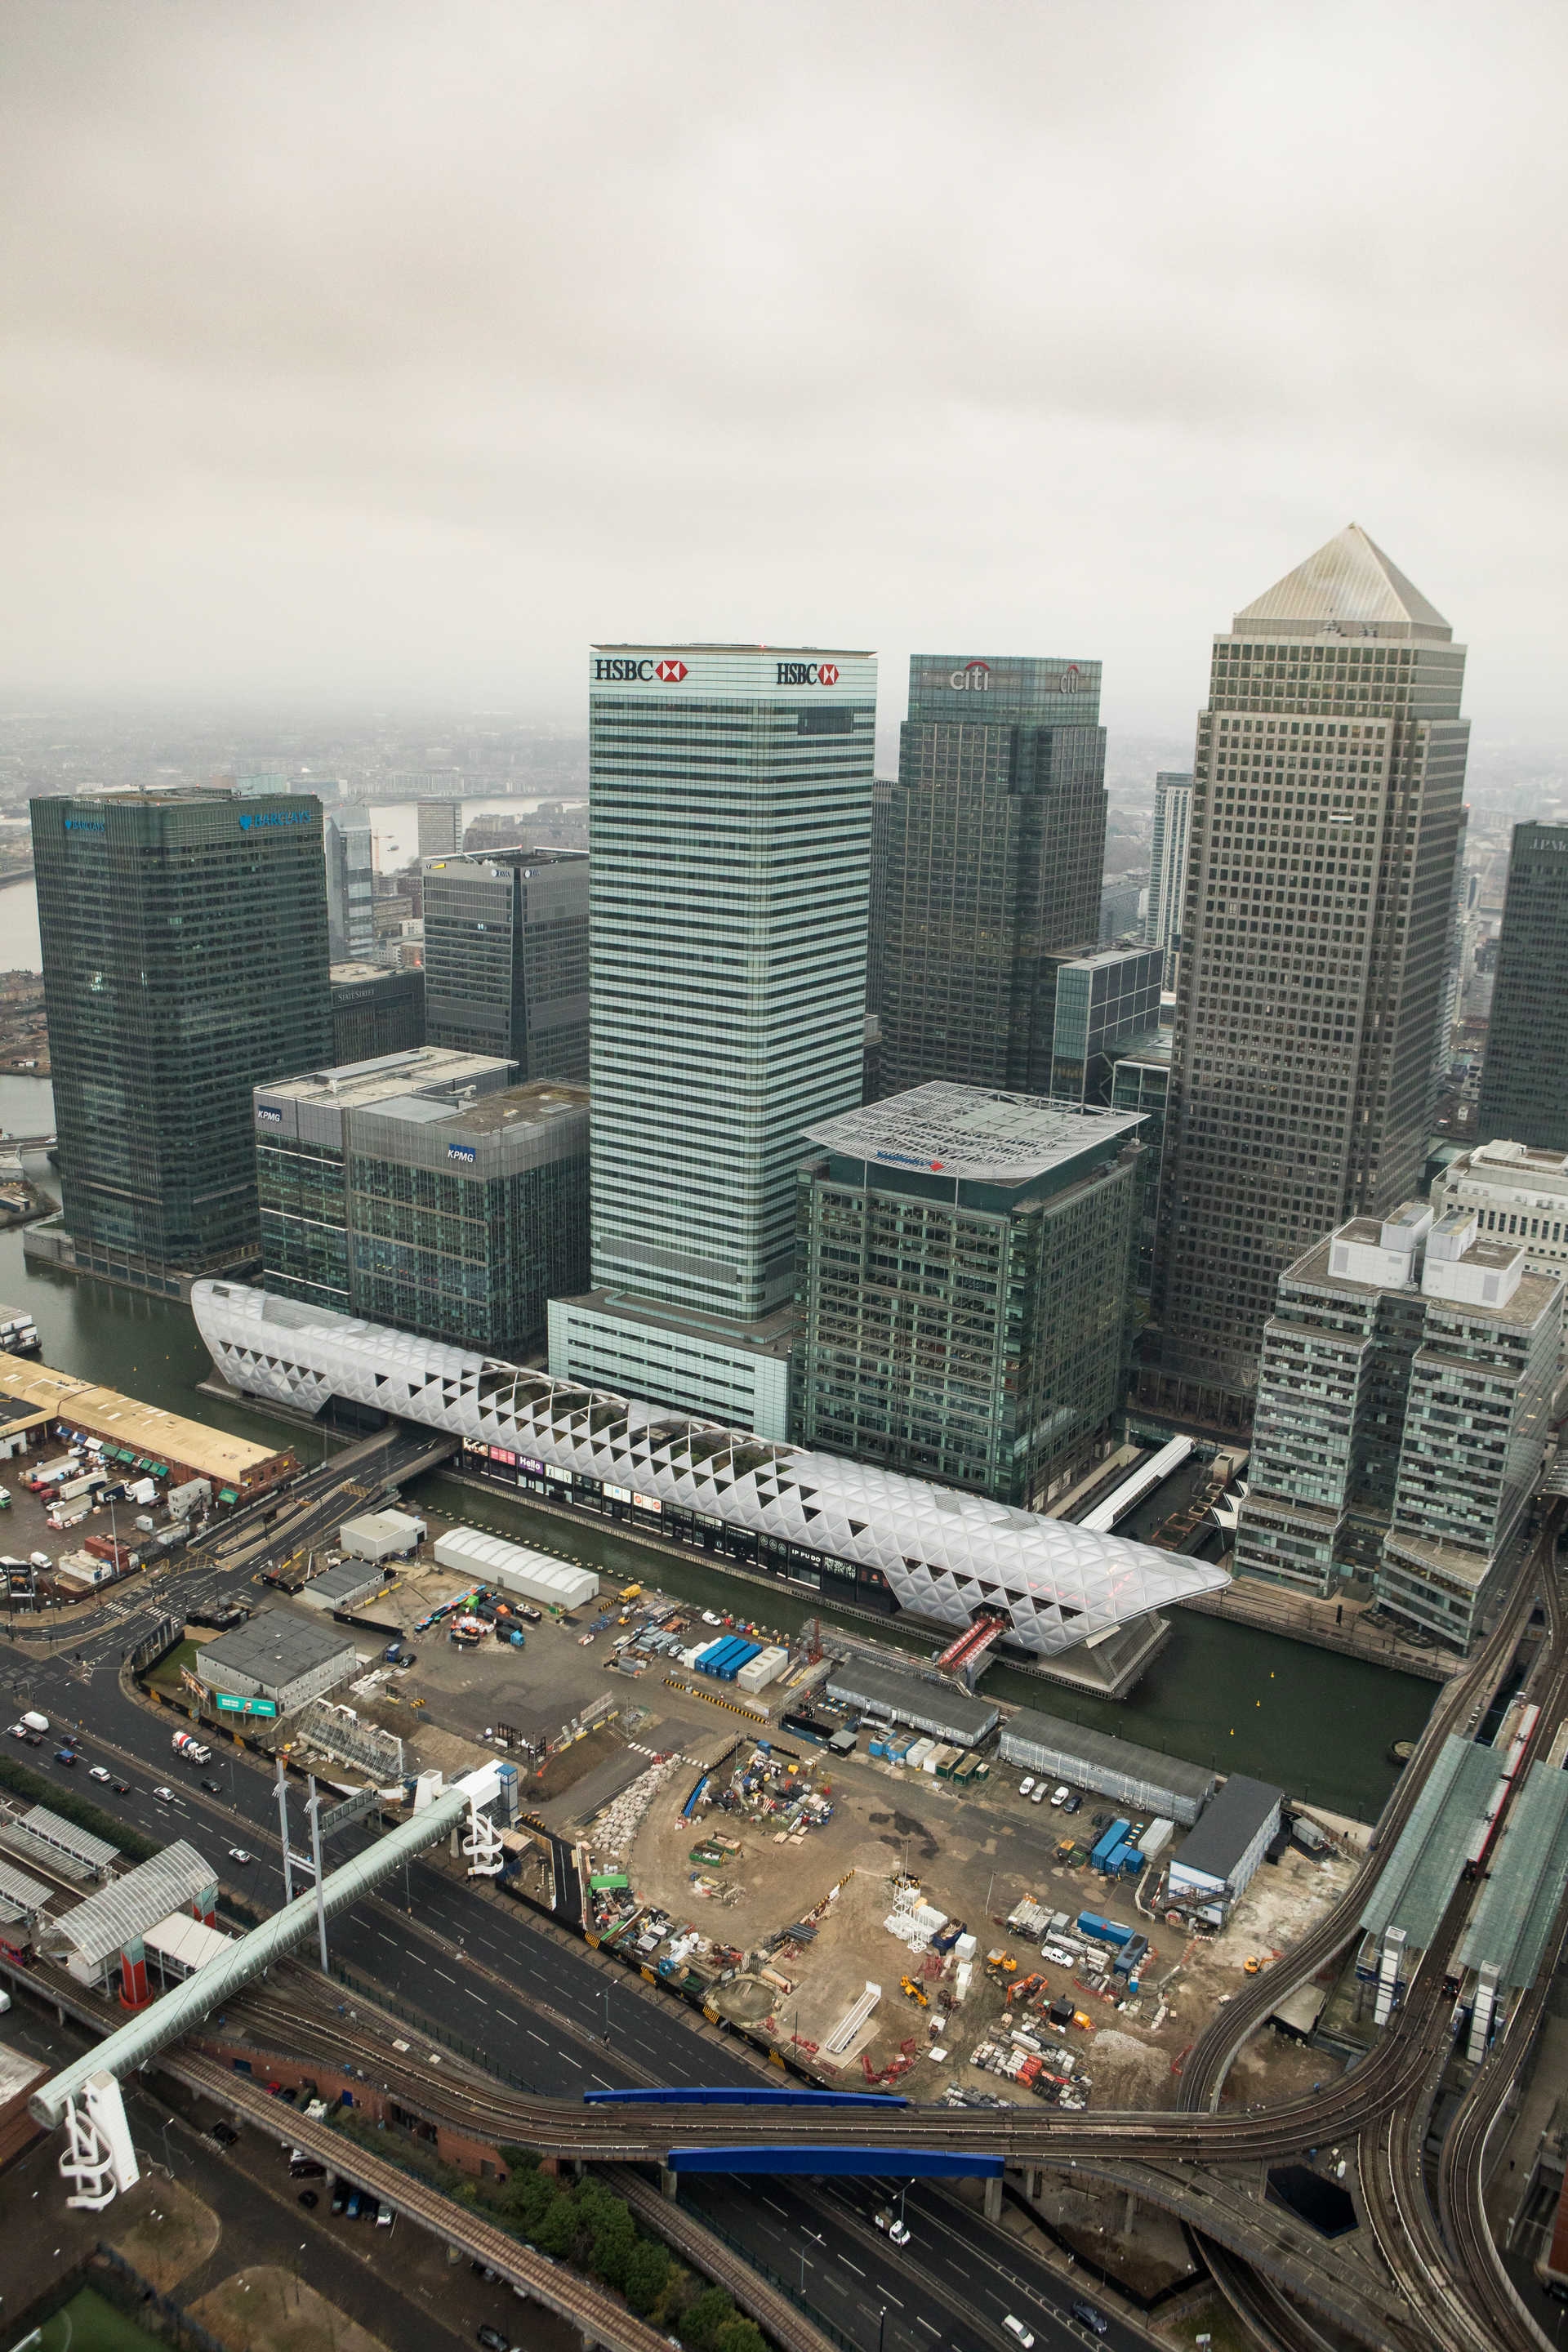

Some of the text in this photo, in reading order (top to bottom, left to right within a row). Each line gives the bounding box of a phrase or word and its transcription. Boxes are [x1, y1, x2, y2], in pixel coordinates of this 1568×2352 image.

[595, 659, 653, 682] HSBC
[777, 662, 817, 685] HSBC
[949, 666, 990, 691] citi
[1060, 667, 1079, 693] citi
[73, 821, 105, 832] BARCLAYS
[254, 810, 311, 828] BARCLAYS
[257, 1109, 282, 1123] KPMG
[448, 1148, 474, 1163] KPMG
[519, 1456, 541, 1470] Hello
